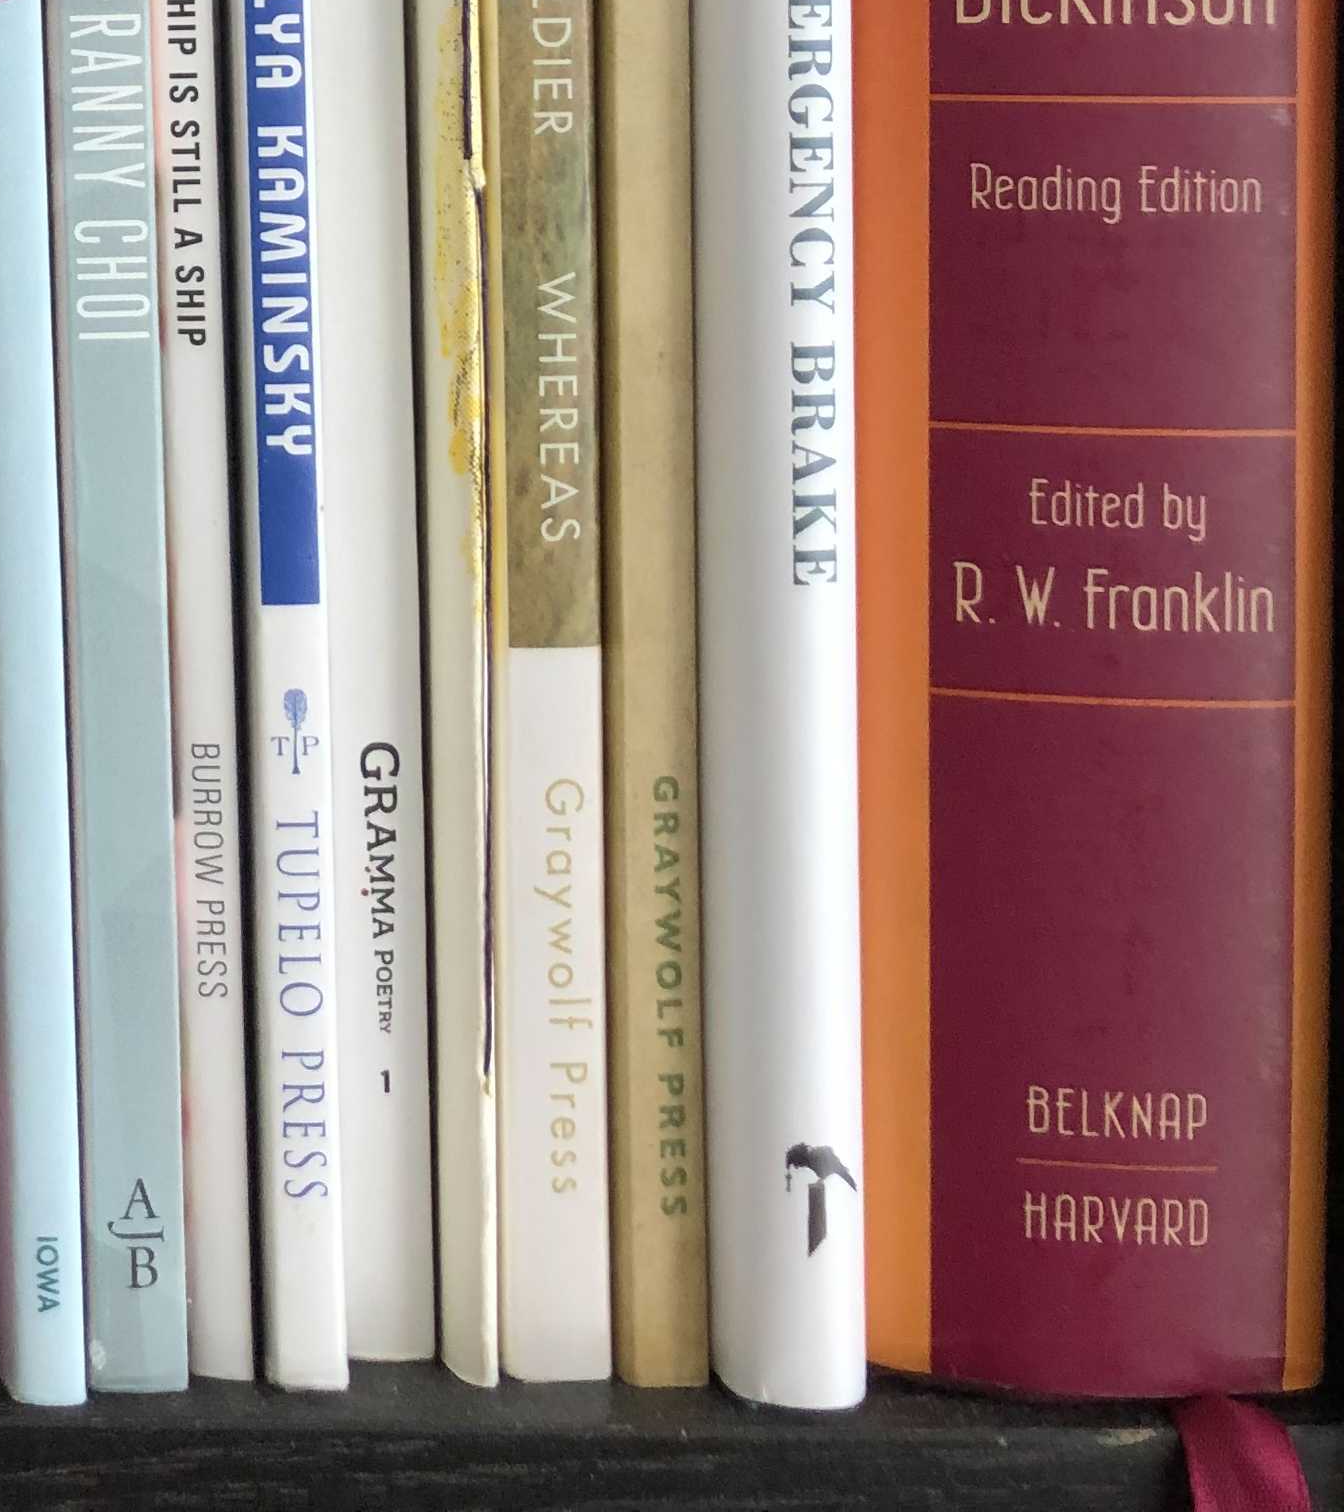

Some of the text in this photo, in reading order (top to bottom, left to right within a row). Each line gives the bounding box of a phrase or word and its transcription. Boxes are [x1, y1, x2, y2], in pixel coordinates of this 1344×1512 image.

[168, 69, 200, 105] IS
[169, 119, 203, 215] STILL
[969, 162, 1263, 225] Reading Edition
[72, 219, 151, 341] CHOI
[173, 227, 203, 250] A
[174, 264, 207, 348] SHIP
[254, 125, 313, 457] KAMINSKY
[535, 270, 581, 544] WHEREAS
[788, 340, 838, 587] BRAKE
[1029, 477, 1207, 542] Edited by
[952, 561, 1275, 633] R. W. Franklin
[191, 742, 229, 999] BURROW PRESS
[360, 741, 401, 939] GRAMMA
[274, 810, 328, 1201] TUPELO PRESS
[374, 948, 395, 1035] POETRY
[534, 778, 593, 1196] Graywolf Press
[652, 775, 688, 1217] GRAYWOLF PRESS
[1026, 1084, 1208, 1142] BELKNAP
[1023, 1191, 1209, 1248] HARVARD
[35, 1235, 61, 1314] IOWA
